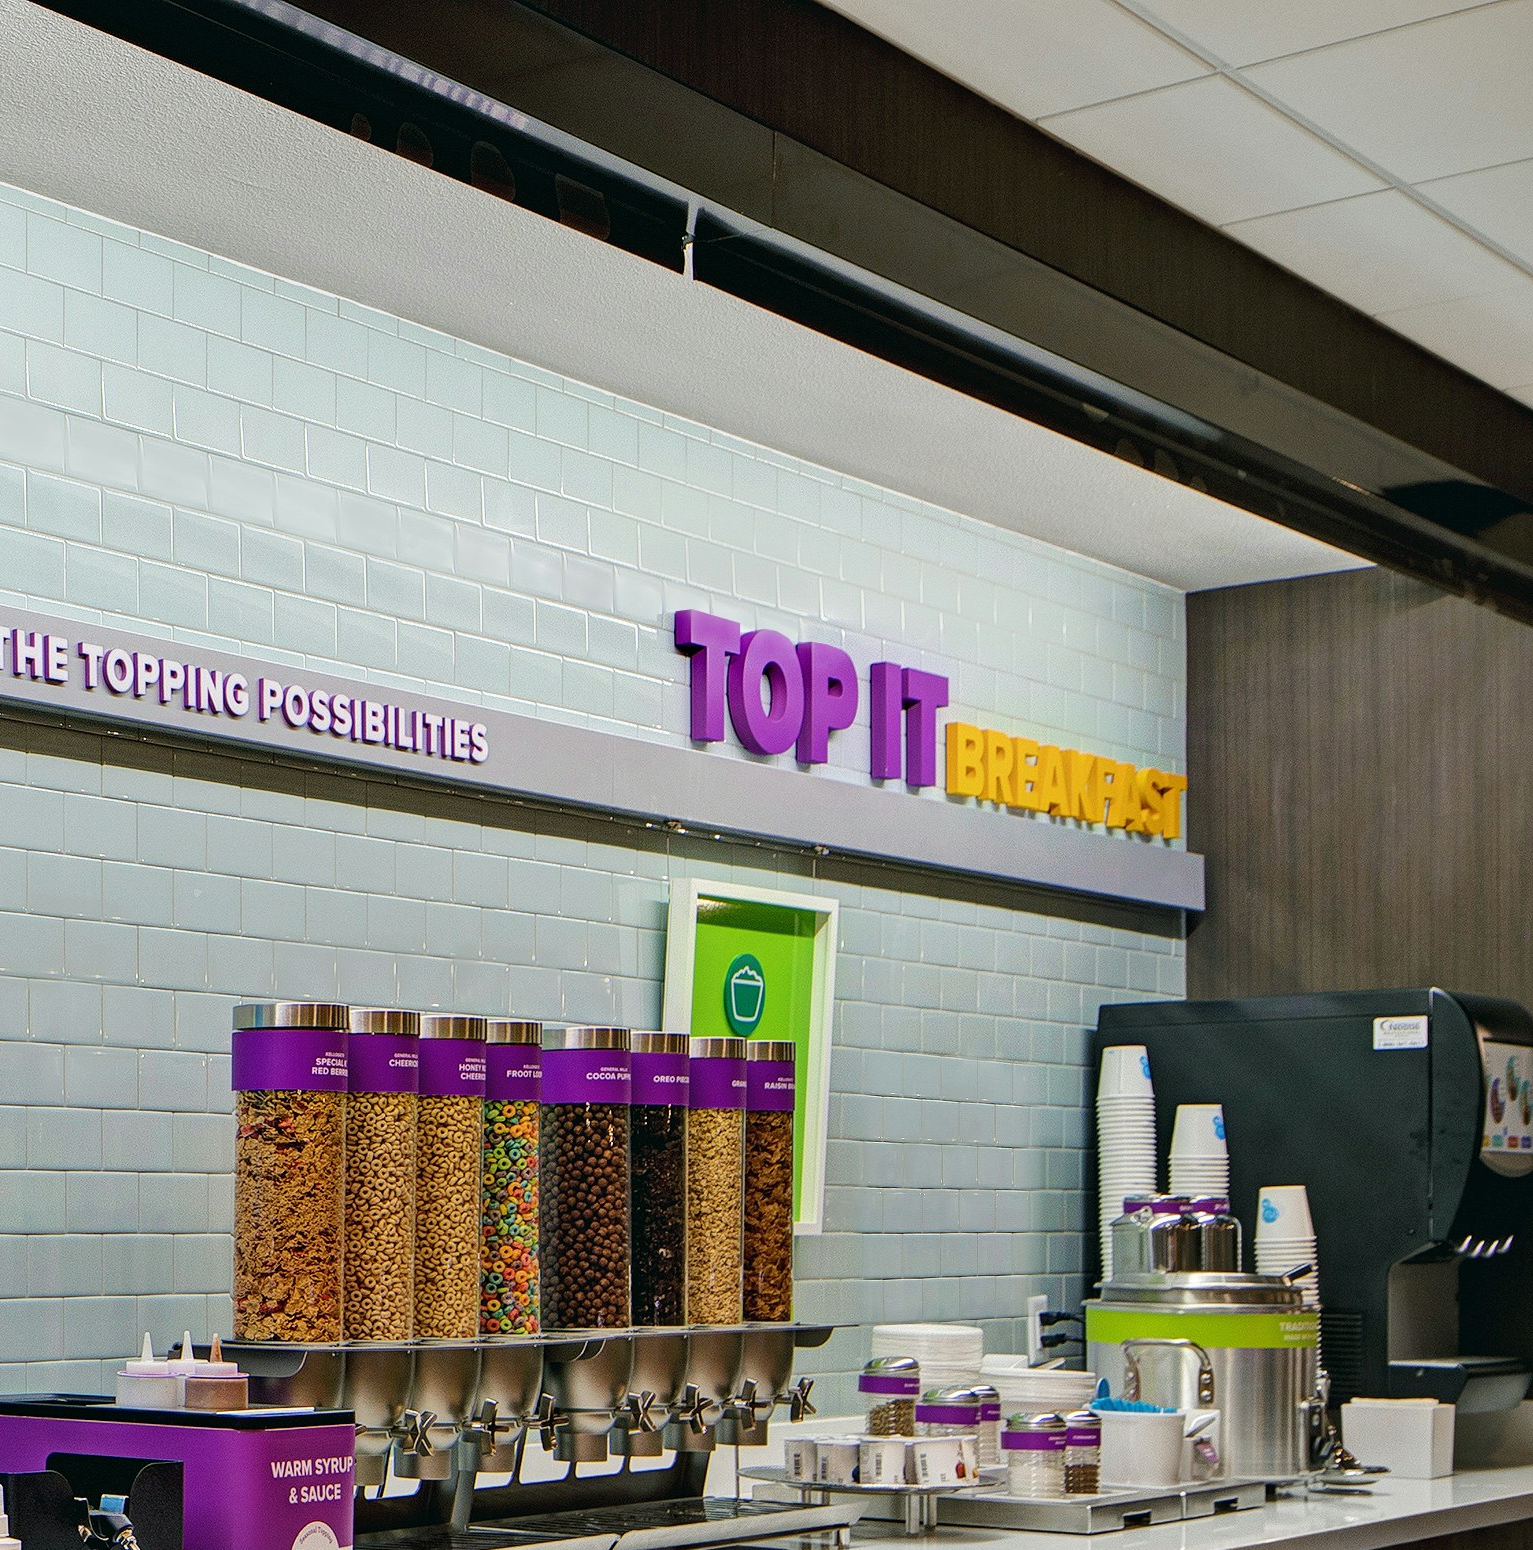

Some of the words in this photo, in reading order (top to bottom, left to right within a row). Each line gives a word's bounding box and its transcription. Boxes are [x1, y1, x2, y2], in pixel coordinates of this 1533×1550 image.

[78, 641, 249, 717] TOPPING
[258, 676, 489, 763] POSSIBILITIES
[674, 609, 859, 764] TOP
[870, 661, 949, 786] IT
[945, 721, 1188, 839] BREAKFAST
[312, 1066, 330, 1075] RED
[315, 1058, 344, 1067] SPECIAL
[506, 1069, 532, 1078] FROOT
[586, 1072, 616, 1080] COCOA
[653, 1075, 676, 1083] OREO
[270, 1458, 313, 1479] WARM
[314, 1455, 354, 1476] SYRUP
[288, 1486, 299, 1504] &
[300, 1483, 342, 1503] SAUCE
[299, 1525, 318, 1544] Seasonal
[317, 1526, 334, 1544] Topping
